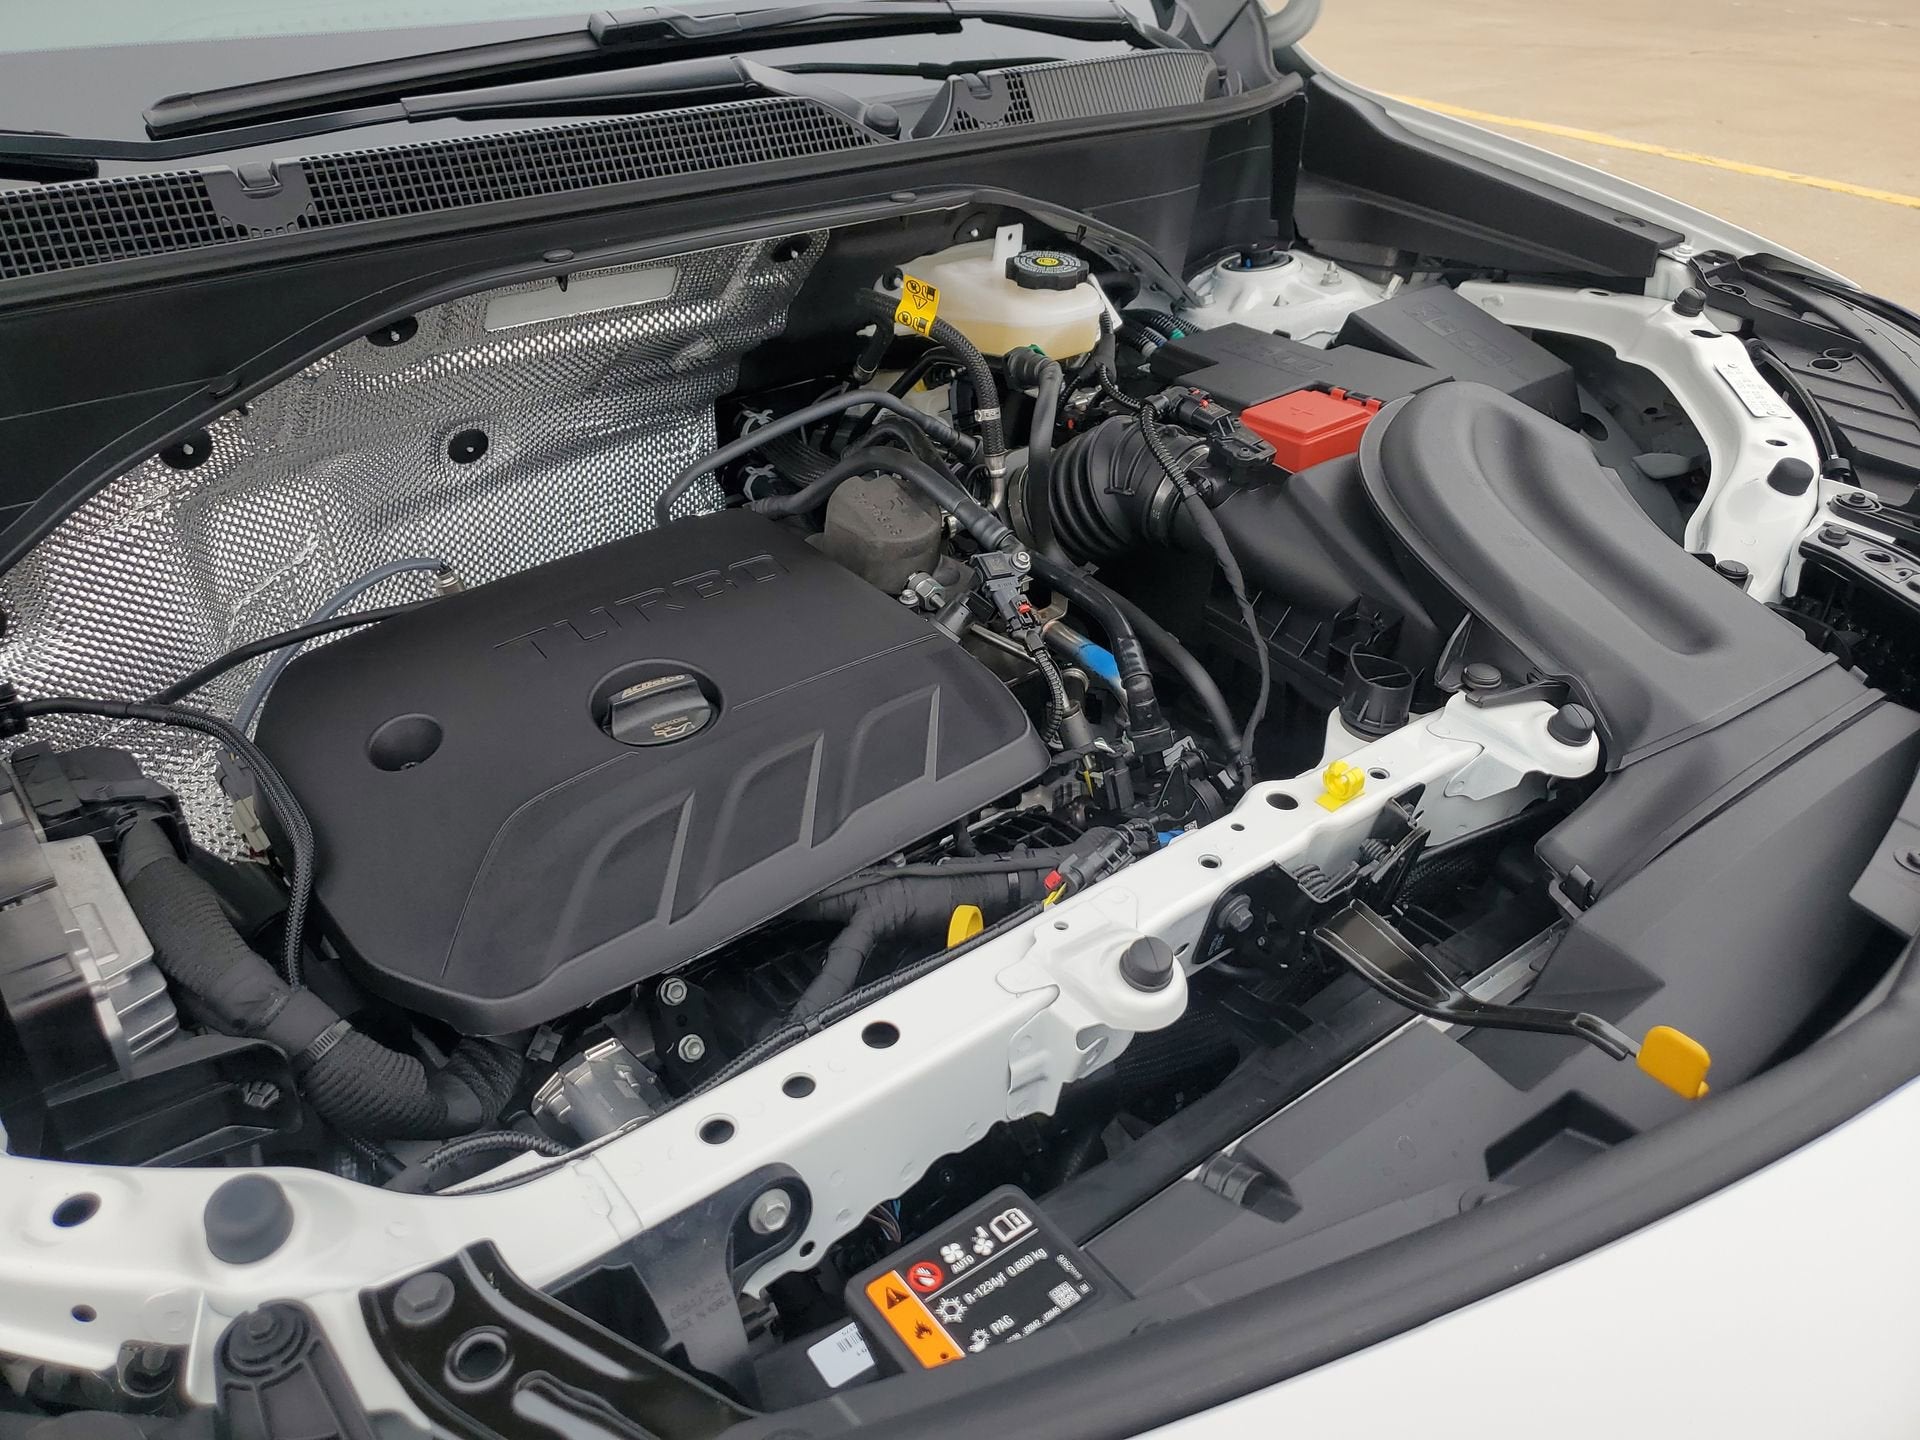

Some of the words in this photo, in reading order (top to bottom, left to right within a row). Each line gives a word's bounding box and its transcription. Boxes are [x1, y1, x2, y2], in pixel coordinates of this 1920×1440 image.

[493, 553, 791, 659] TURBO
[952, 1254, 975, 1273] AUTO
[963, 1271, 1007, 1305] R-1234yf
[1006, 1254, 1034, 1277] 0.600
[1032, 1247, 1048, 1264] kg
[989, 1314, 1015, 1335] PAG
